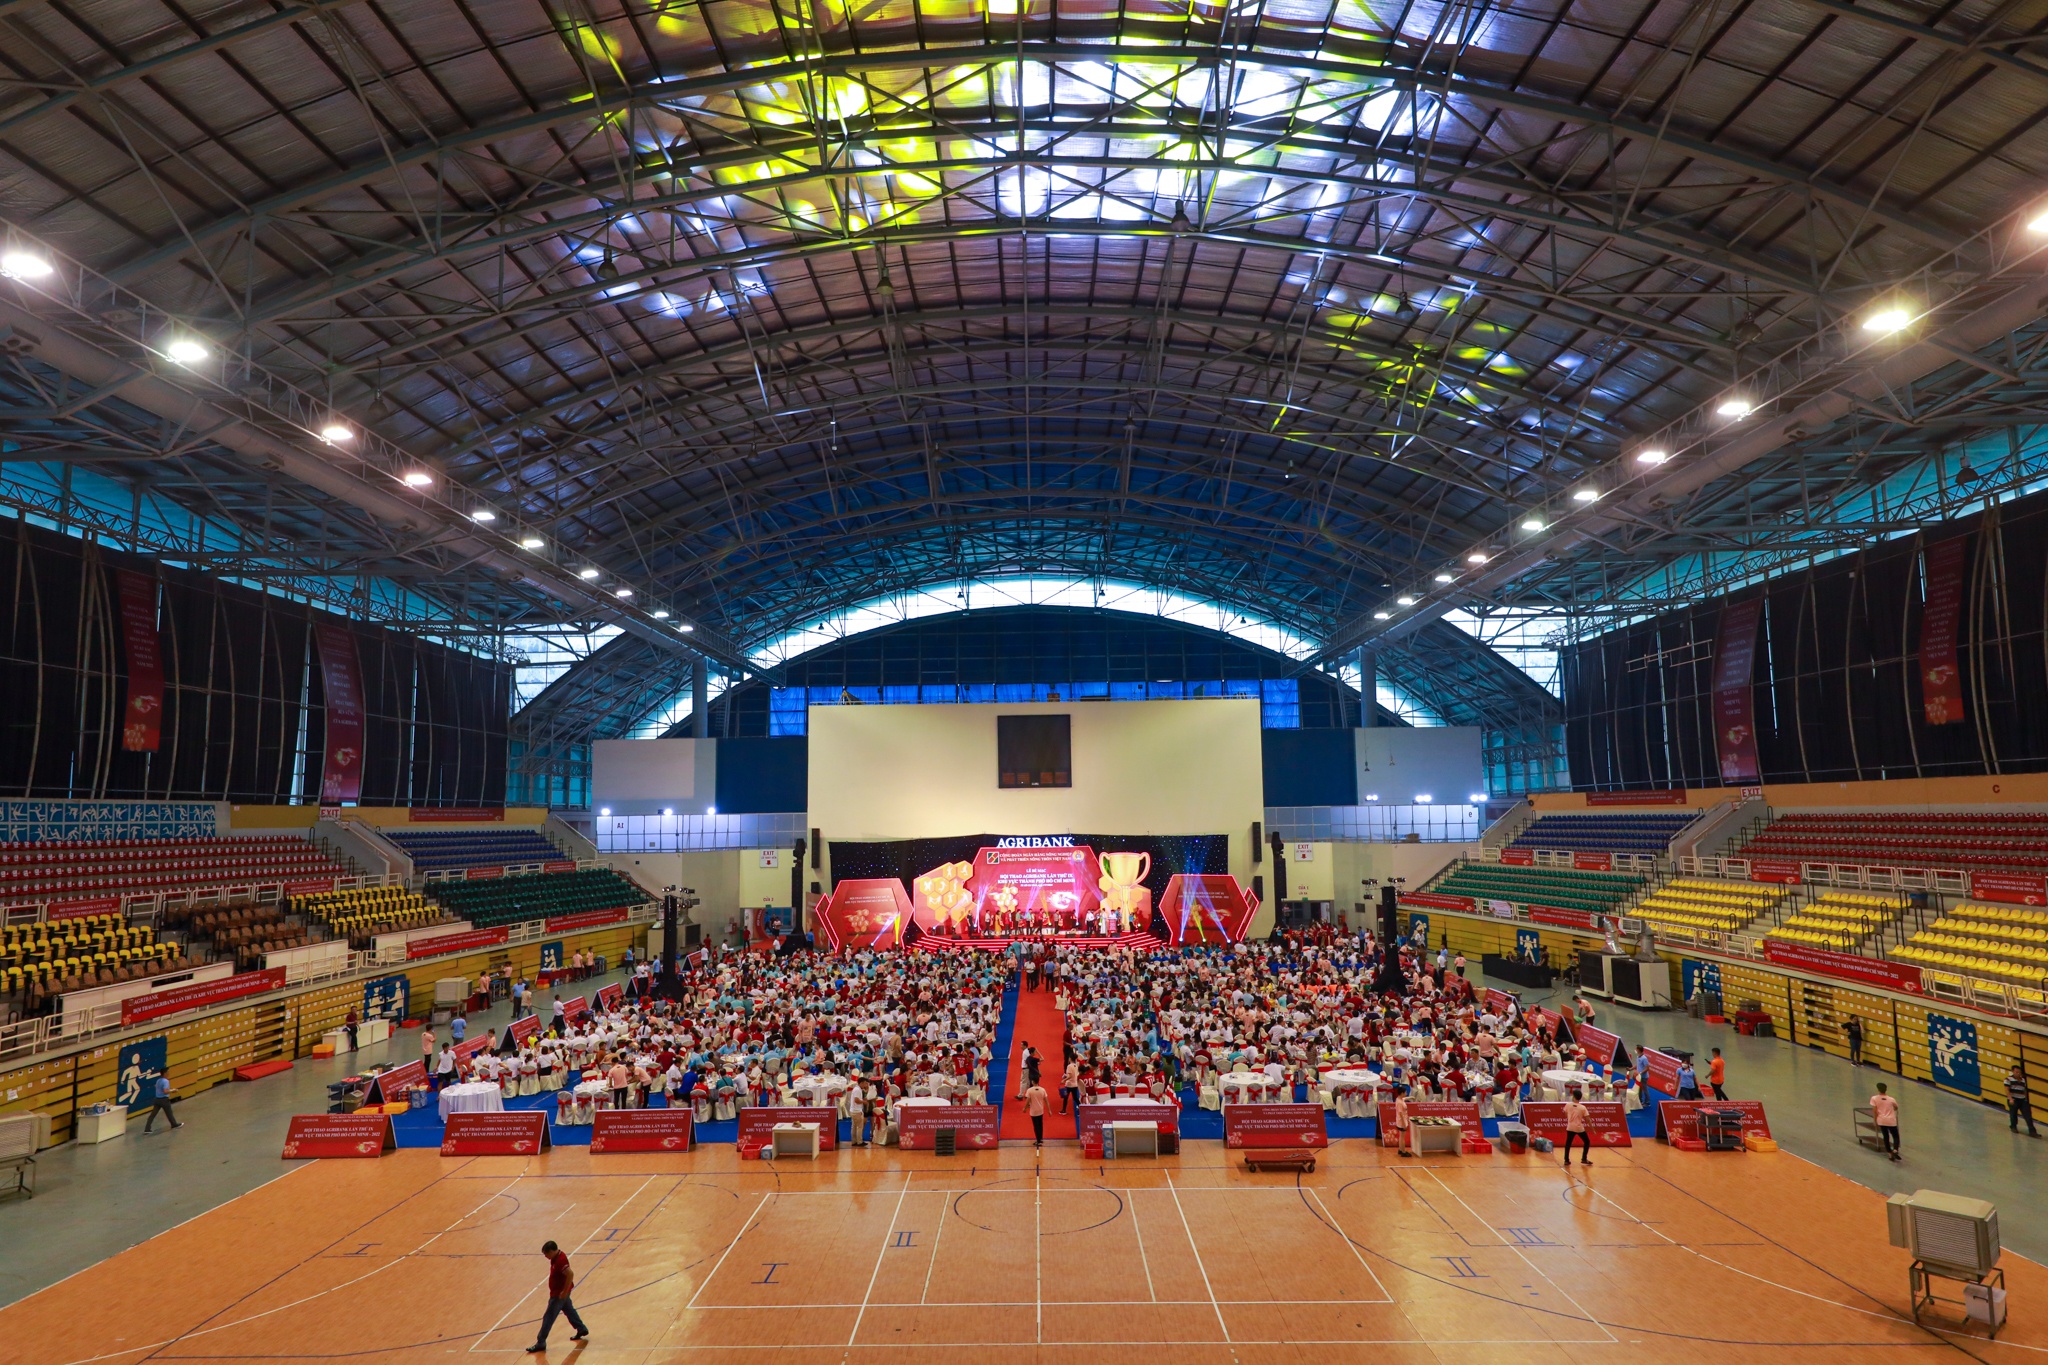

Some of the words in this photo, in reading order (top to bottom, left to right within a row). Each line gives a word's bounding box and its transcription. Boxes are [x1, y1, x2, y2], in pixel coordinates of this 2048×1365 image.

[1742, 788, 1760, 797] EXIT
[1992, 785, 2000, 793] C
[996, 837, 1074, 848] AGRIBANK
[134, 994, 158, 1005] AGRIBANK
